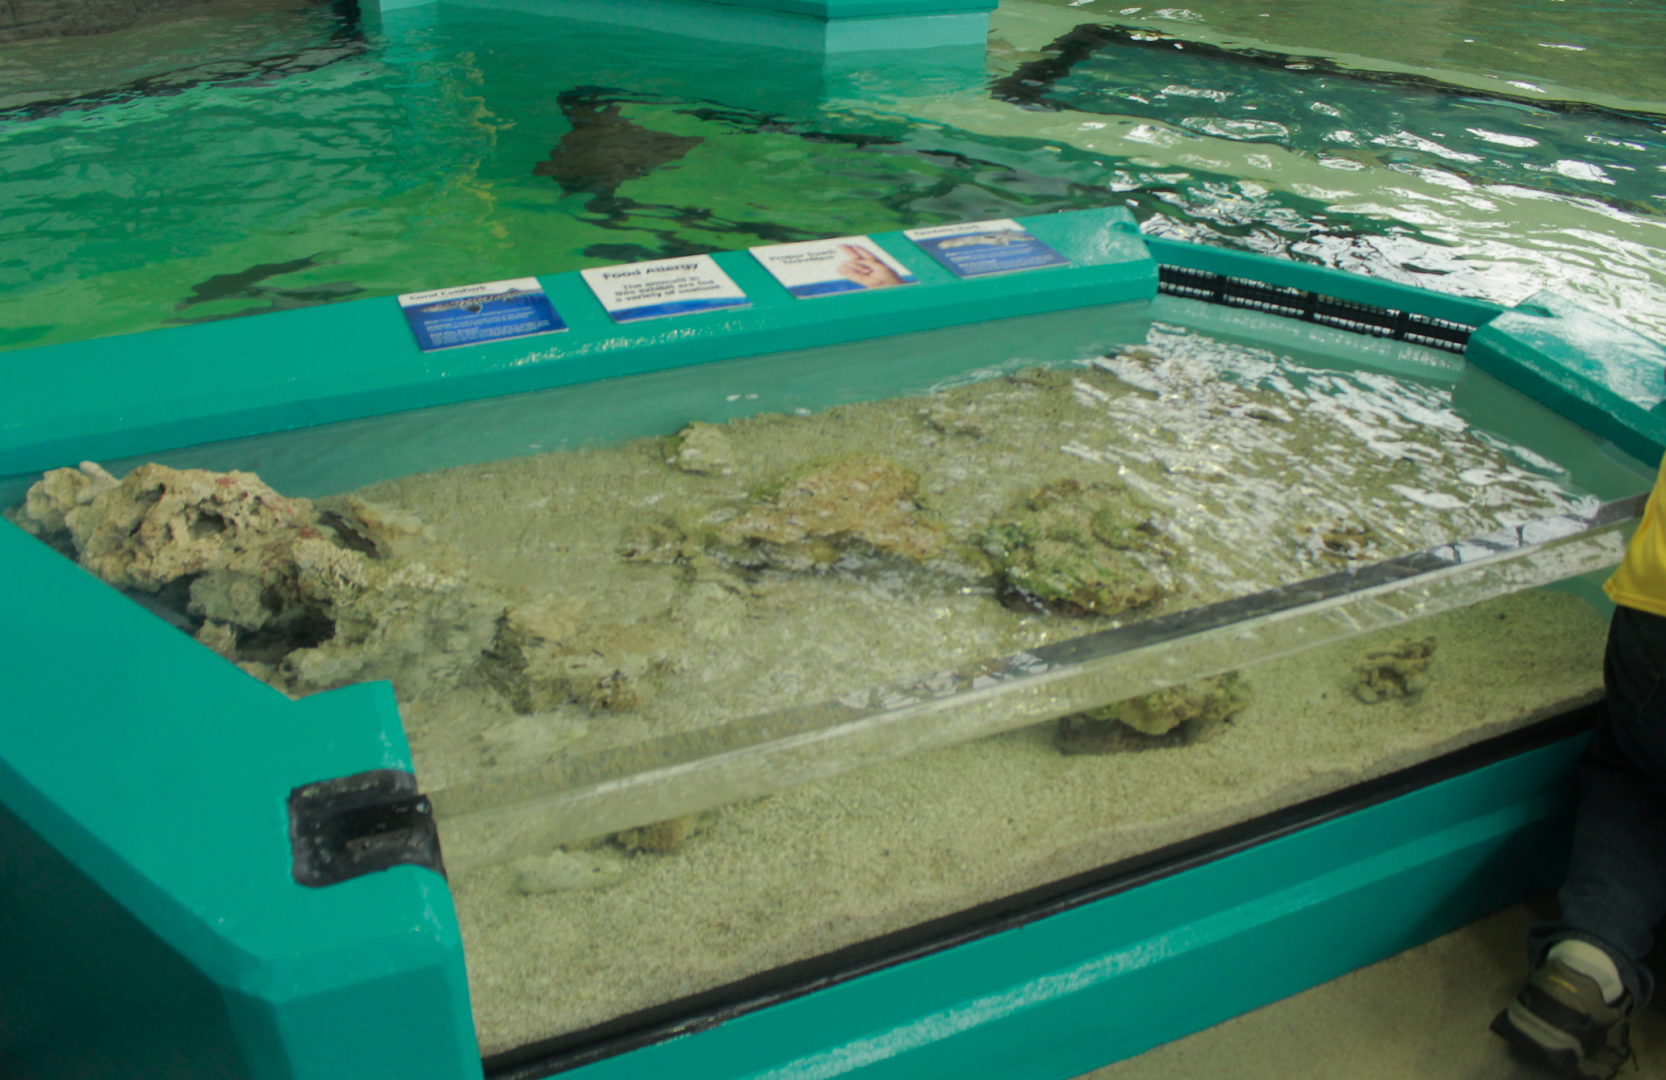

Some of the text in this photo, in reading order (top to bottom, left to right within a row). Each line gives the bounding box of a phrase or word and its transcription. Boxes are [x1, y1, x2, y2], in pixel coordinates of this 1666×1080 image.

[603, 263, 698, 279] Food Allergy
[645, 277, 687, 286] animals
[638, 285, 674, 294] exhibit
[625, 292, 662, 301] variety
